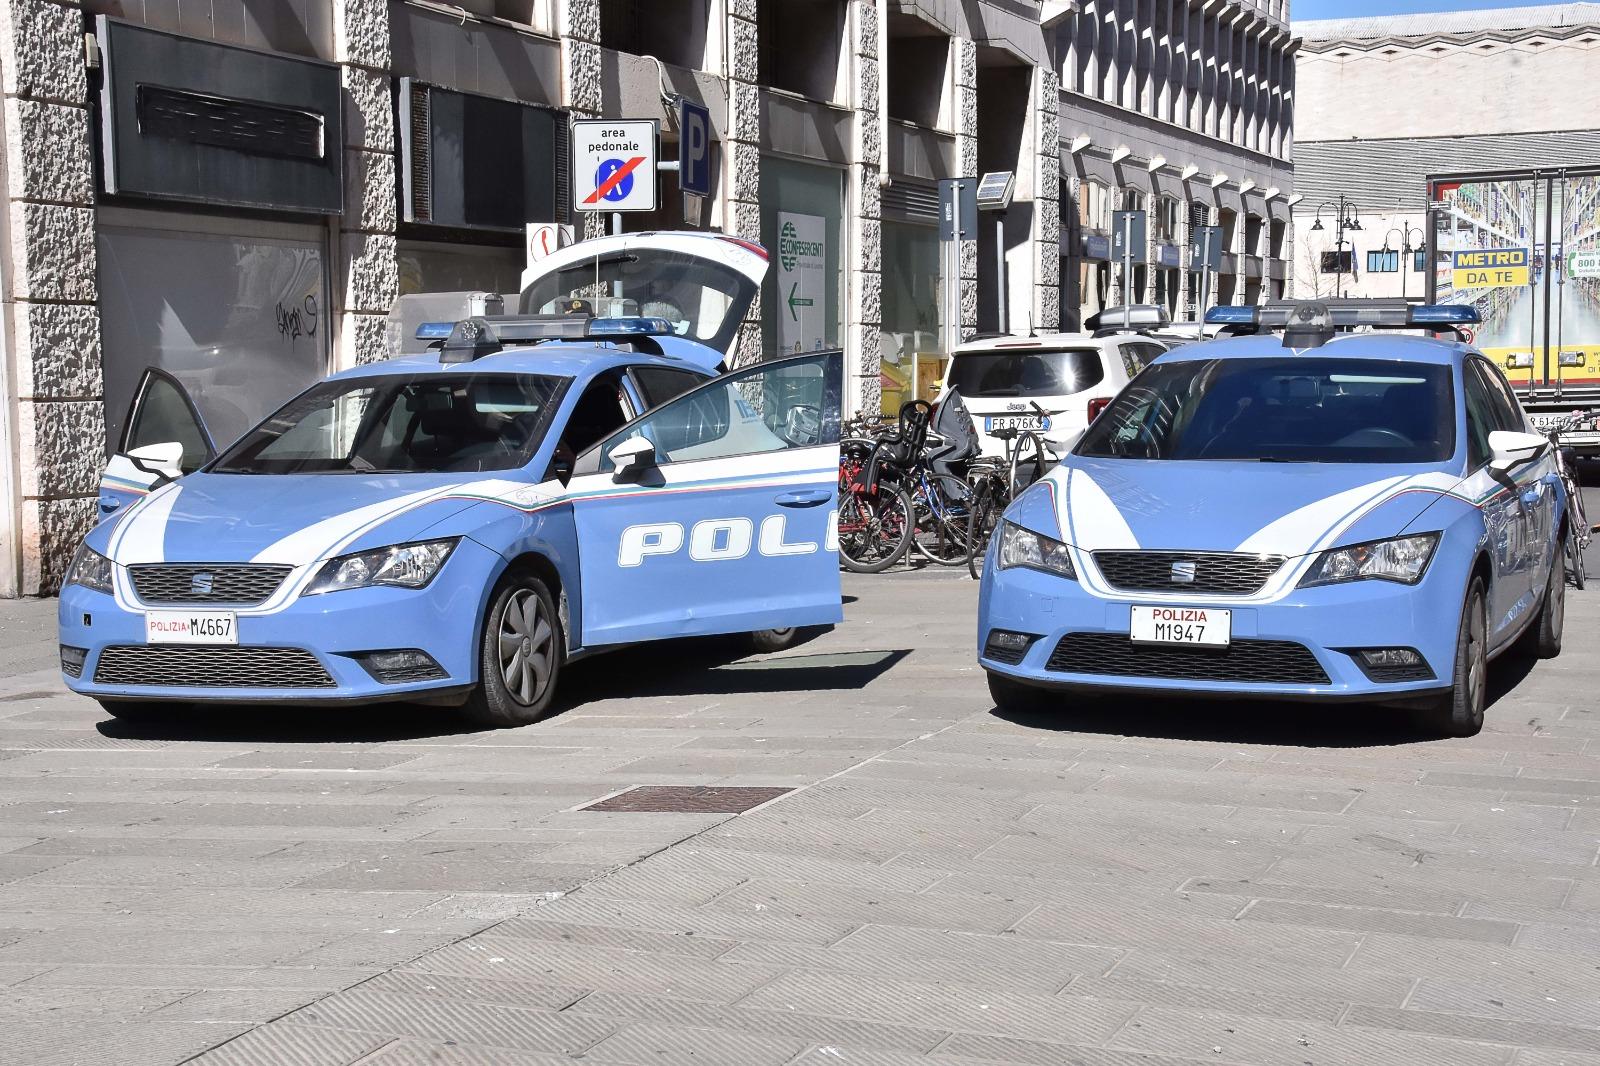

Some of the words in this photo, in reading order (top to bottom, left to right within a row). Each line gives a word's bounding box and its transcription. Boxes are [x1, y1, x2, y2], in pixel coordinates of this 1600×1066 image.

[601, 127, 626, 138] area
[588, 140, 639, 153] pedonale
[687, 111, 706, 184] P
[1457, 251, 1524, 266] METRO
[1578, 259, 1596, 268] 800
[1466, 272, 1489, 284] DA
[1494, 270, 1514, 283] TE
[1007, 402, 1027, 412] Jeep
[1153, 608, 1207, 622] POLIZIA
[150, 621, 187, 631] POLIZIA
[190, 618, 231, 636] M4667
[1155, 623, 1205, 642] M1947
